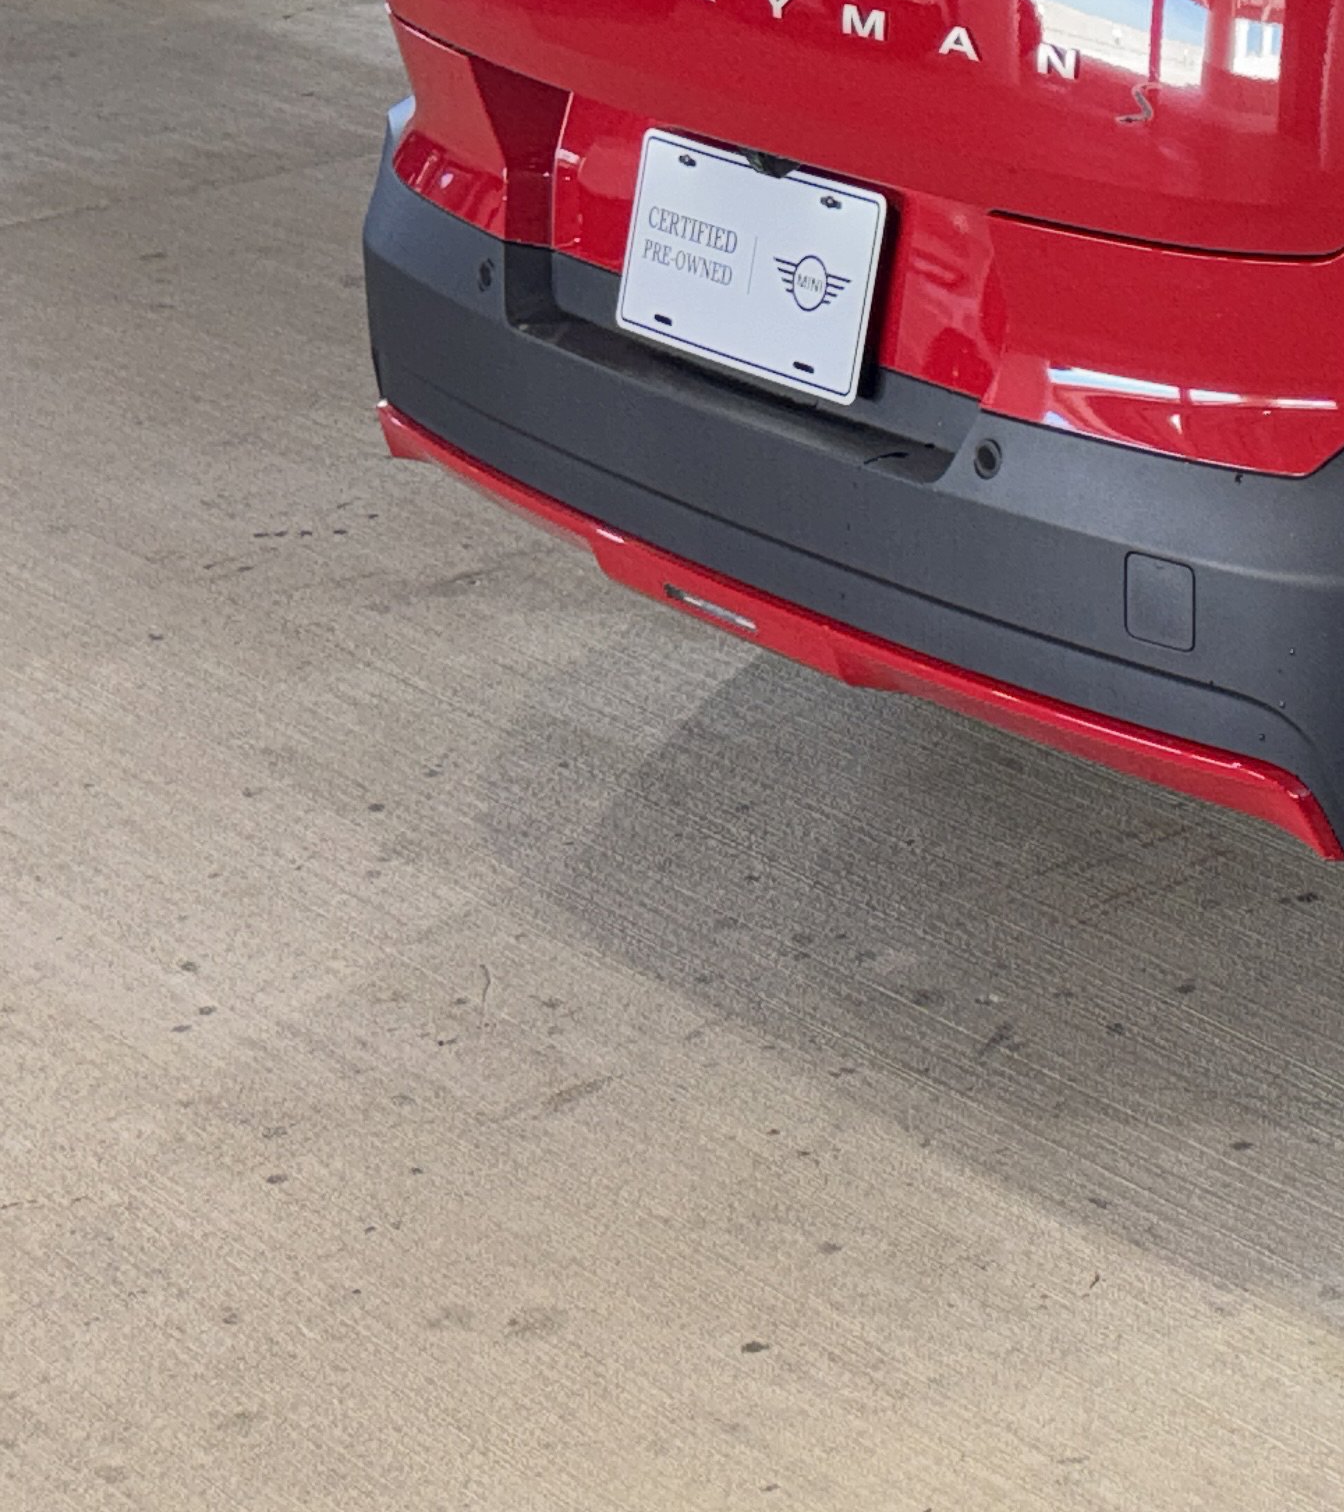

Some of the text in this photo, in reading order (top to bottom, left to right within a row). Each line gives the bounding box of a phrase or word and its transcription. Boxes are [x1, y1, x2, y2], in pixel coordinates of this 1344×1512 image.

[648, 205, 738, 254] CERTIFIED
[642, 239, 733, 286] PRE-OWNED
[797, 274, 823, 293] MINI
